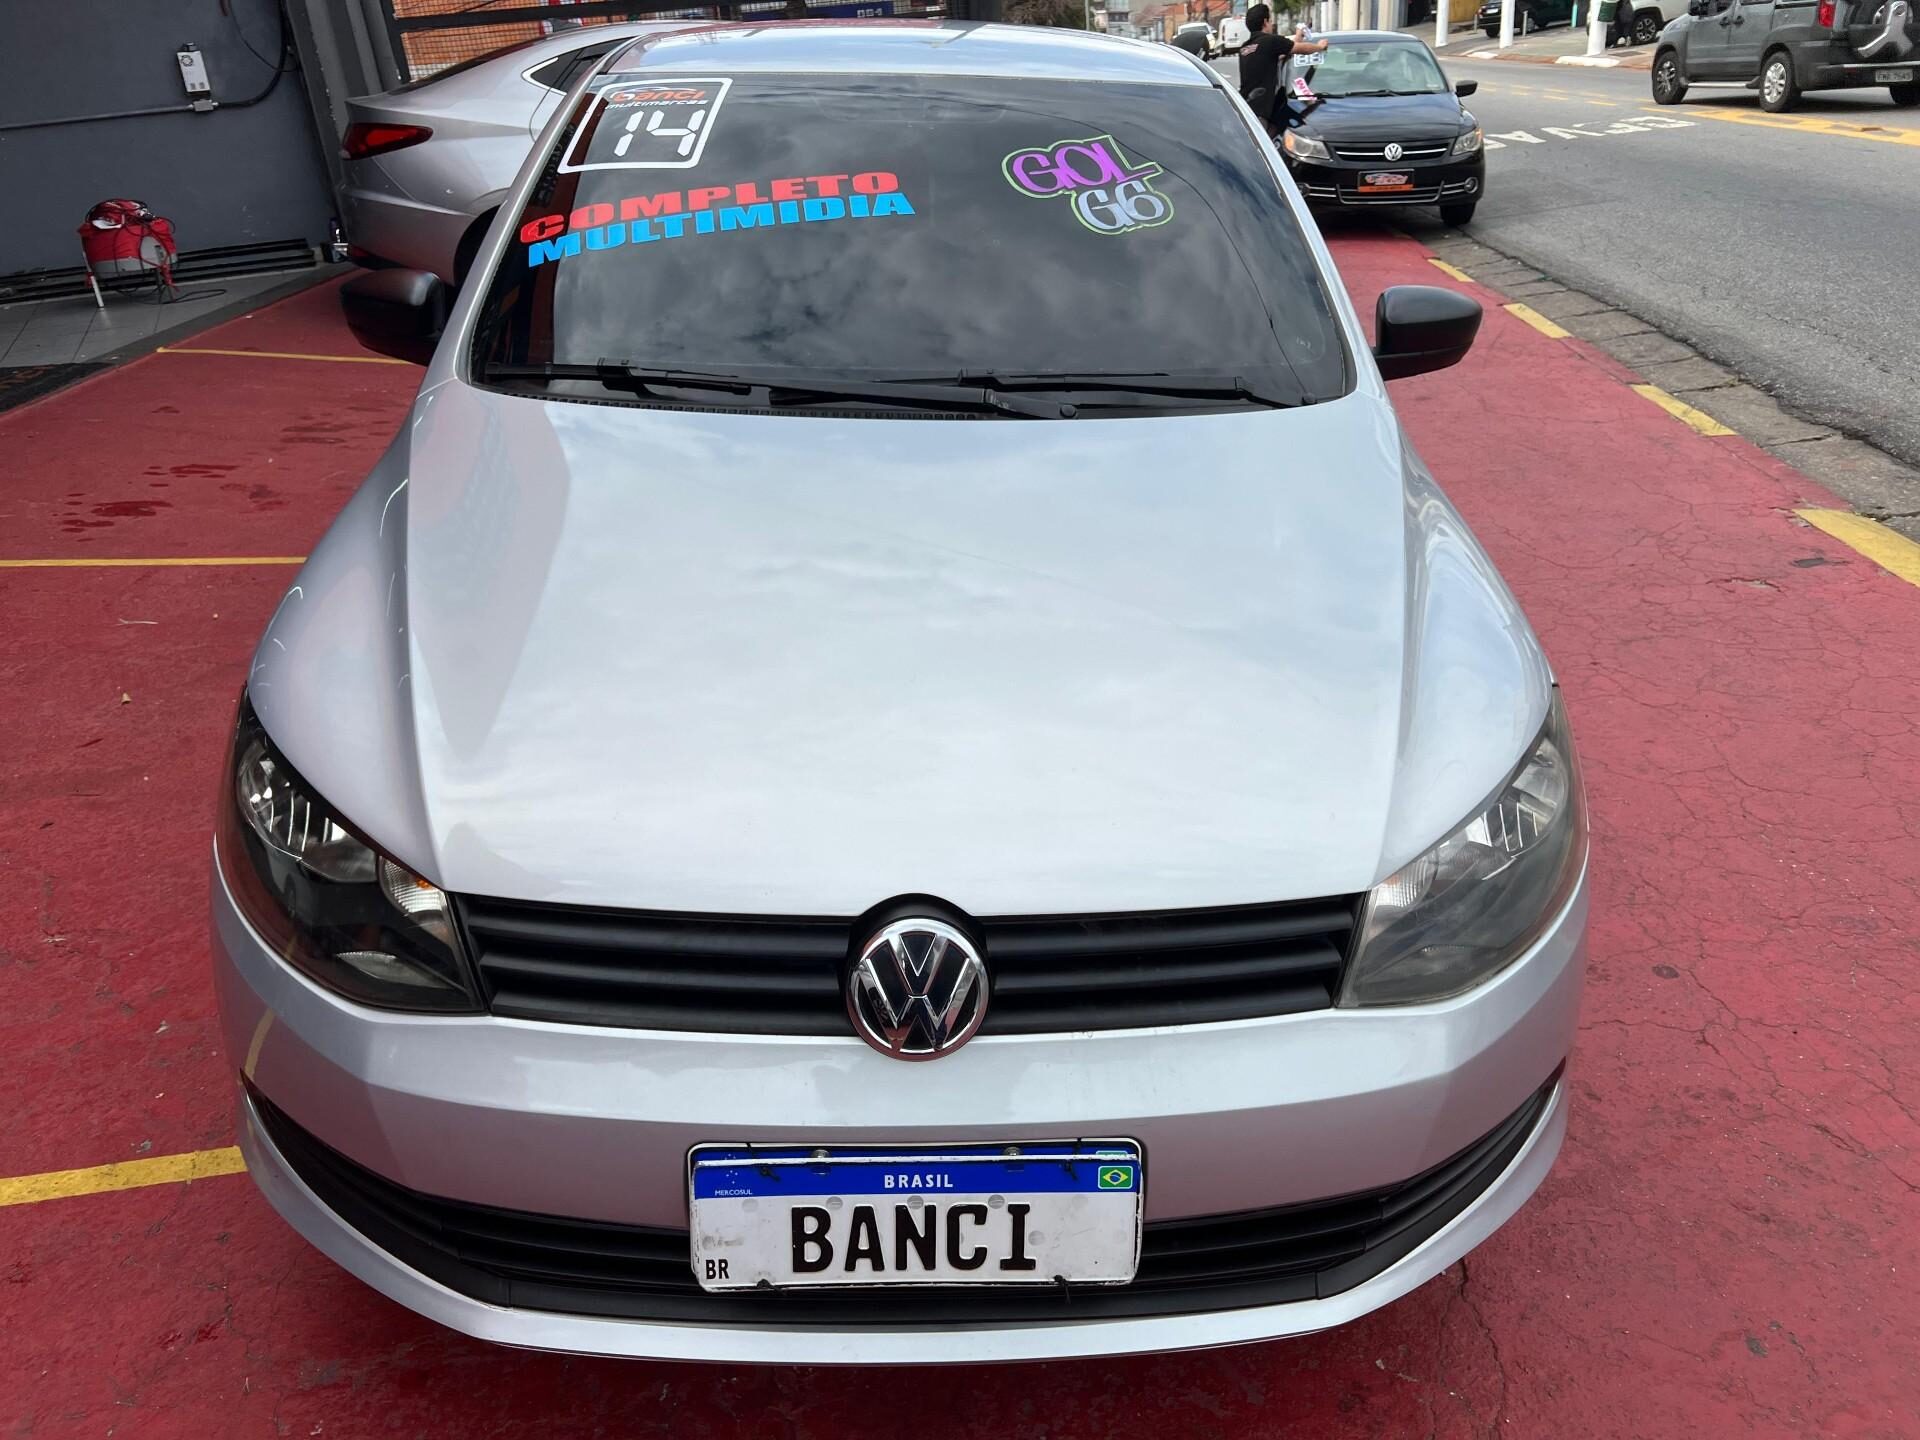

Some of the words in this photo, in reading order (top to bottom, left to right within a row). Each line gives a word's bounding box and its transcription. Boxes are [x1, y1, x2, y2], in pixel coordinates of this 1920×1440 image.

[605, 99, 709, 110] multimarcas
[614, 109, 706, 157] 14
[1012, 142, 1157, 192] GOL
[519, 171, 900, 245] COMPLETO
[1078, 180, 1165, 230] G6
[528, 192, 916, 268] MULTIMIDIA
[714, 1188, 753, 1196] MERCOSUL
[883, 1174, 954, 1189] BRASIL
[791, 1203, 1036, 1272] BANCI
[705, 1259, 729, 1280] BR
